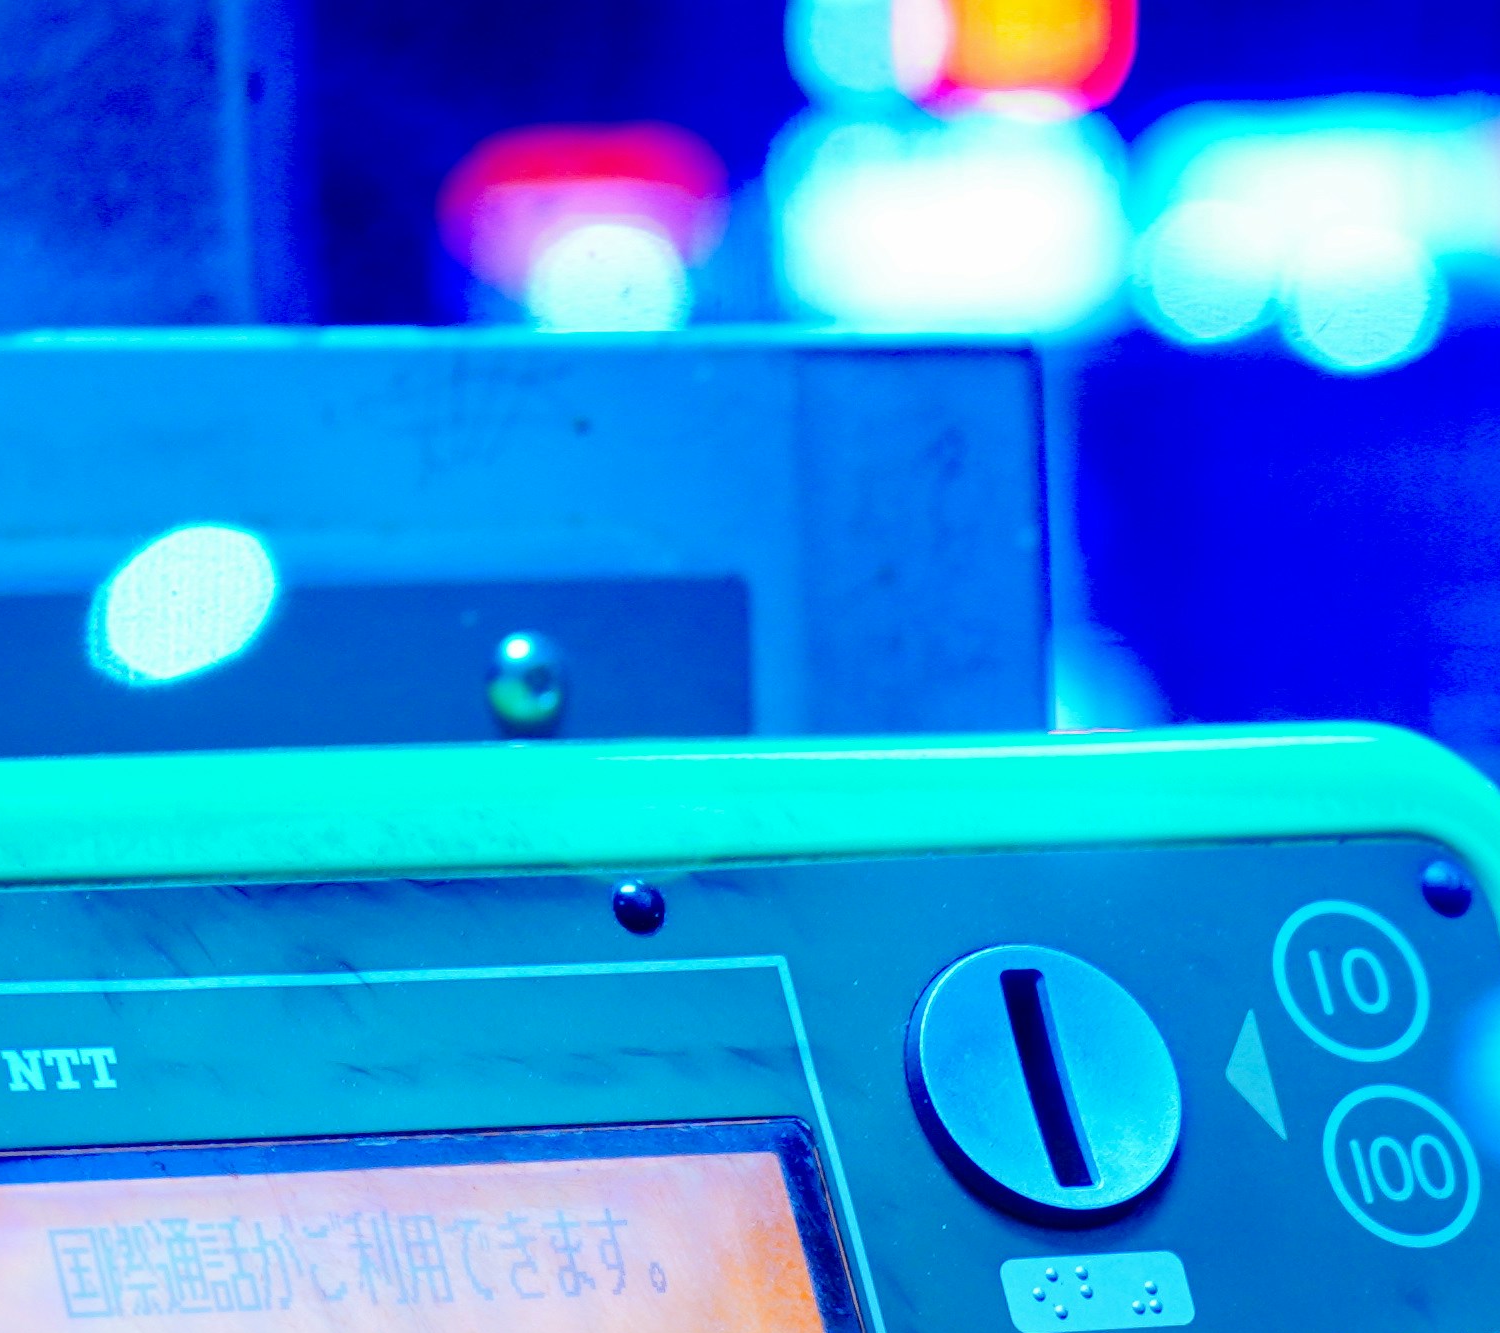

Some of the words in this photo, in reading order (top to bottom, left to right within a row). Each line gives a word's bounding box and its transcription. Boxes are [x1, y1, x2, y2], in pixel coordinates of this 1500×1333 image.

[1308, 948, 1391, 1016] 10
[0, 1045, 119, 1092] NTT
[1349, 1133, 1457, 1204] 100
[46, 1208, 668, 1319] 国際通話がご利用できます。
